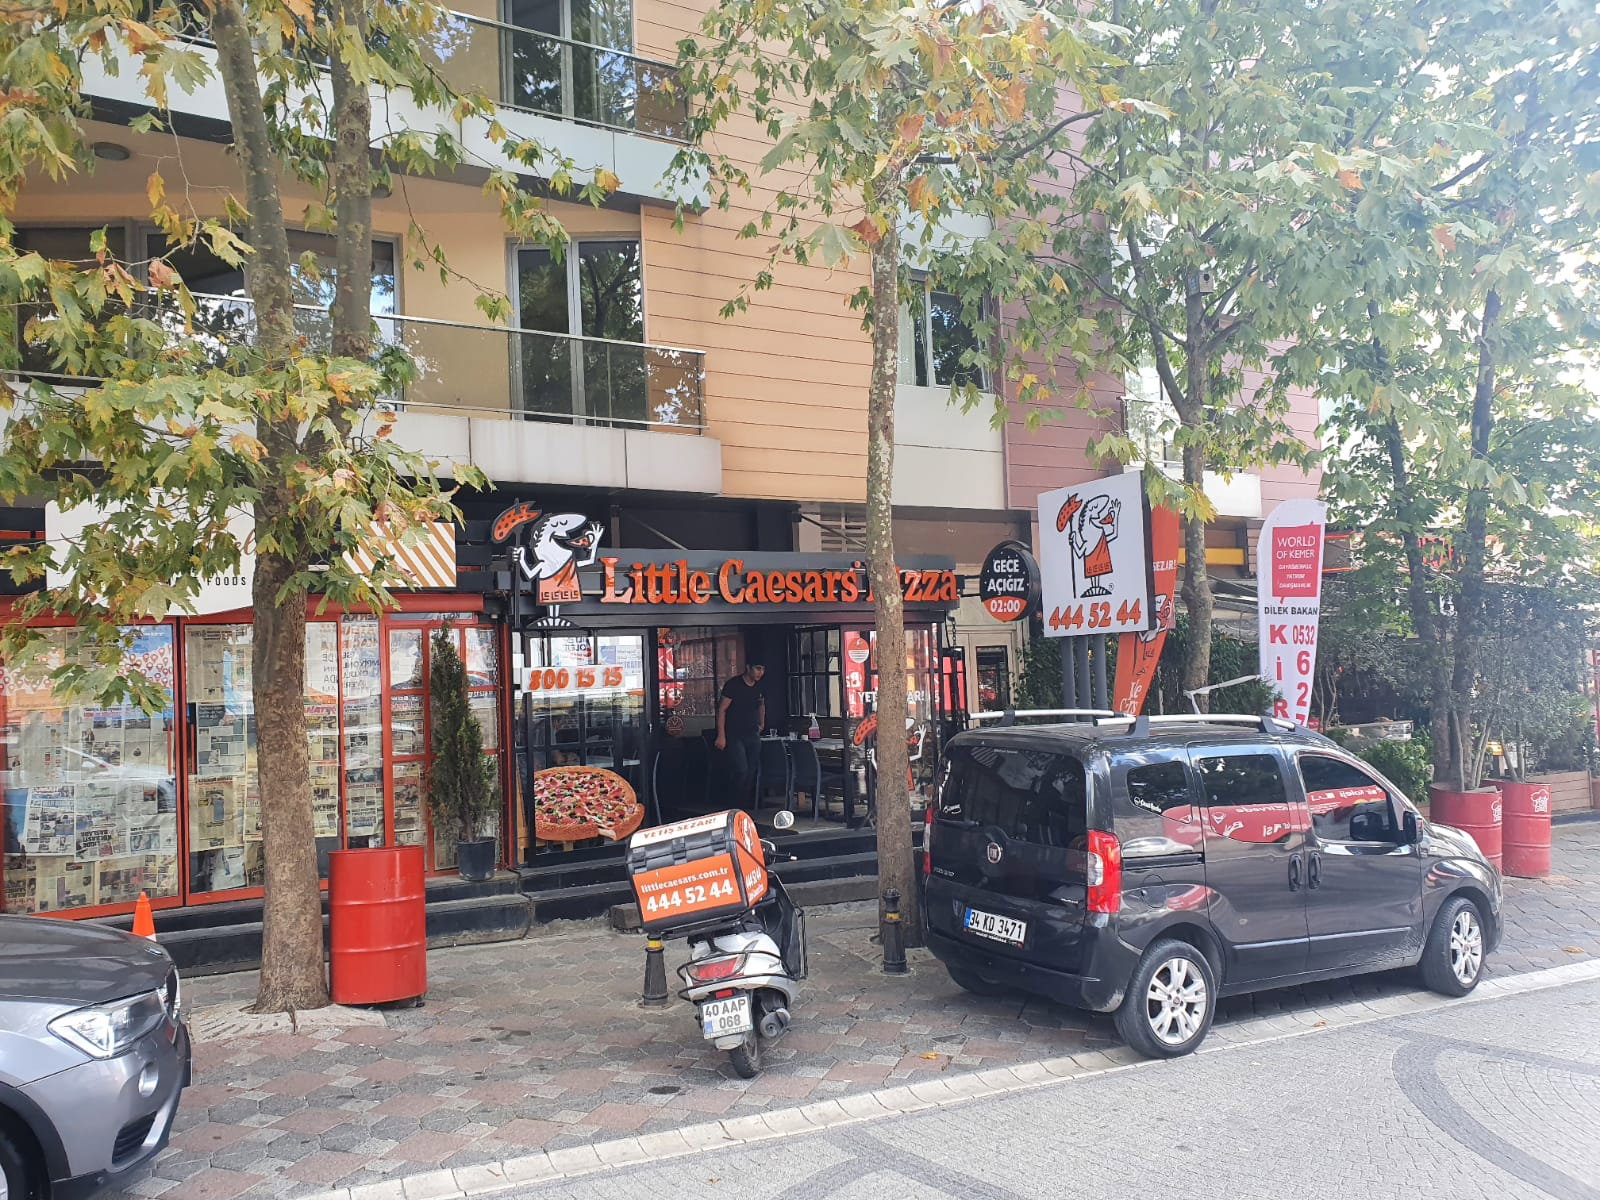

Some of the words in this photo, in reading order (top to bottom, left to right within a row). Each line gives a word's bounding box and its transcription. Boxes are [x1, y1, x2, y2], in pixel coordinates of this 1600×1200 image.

[1277, 535, 1315, 548] WORLD
[1276, 550, 1288, 560] OF
[1289, 549, 1315, 559] KEMER
[993, 559, 1020, 573] GECE
[207, 576, 247, 586] FOODS
[599, 557, 711, 604] Little
[719, 559, 858, 604] Caesars
[866, 565, 960, 603] zza
[987, 574, 1025, 596] AÇIĞIZ
[990, 599, 1020, 613] 02:00
[1048, 604, 1084, 631] 444
[1088, 601, 1111, 628] 52
[1116, 597, 1141, 625] 44
[1264, 603, 1288, 615] DİLEK
[1291, 606, 1318, 615] BAKAN
[1292, 624, 1315, 645] 0532
[576, 667, 596, 688] 15
[603, 666, 623, 687] 15
[640, 867, 729, 893] littlecaesars.com.tr
[647, 890, 682, 912] 444
[685, 885, 706, 905] 52
[709, 879, 733, 898] 44
[969, 911, 980, 927] 34
[997, 919, 1022, 939] 3471
[705, 1004, 719, 1017] 40
[721, 998, 746, 1015] AAP
[719, 1014, 741, 1029] 068
